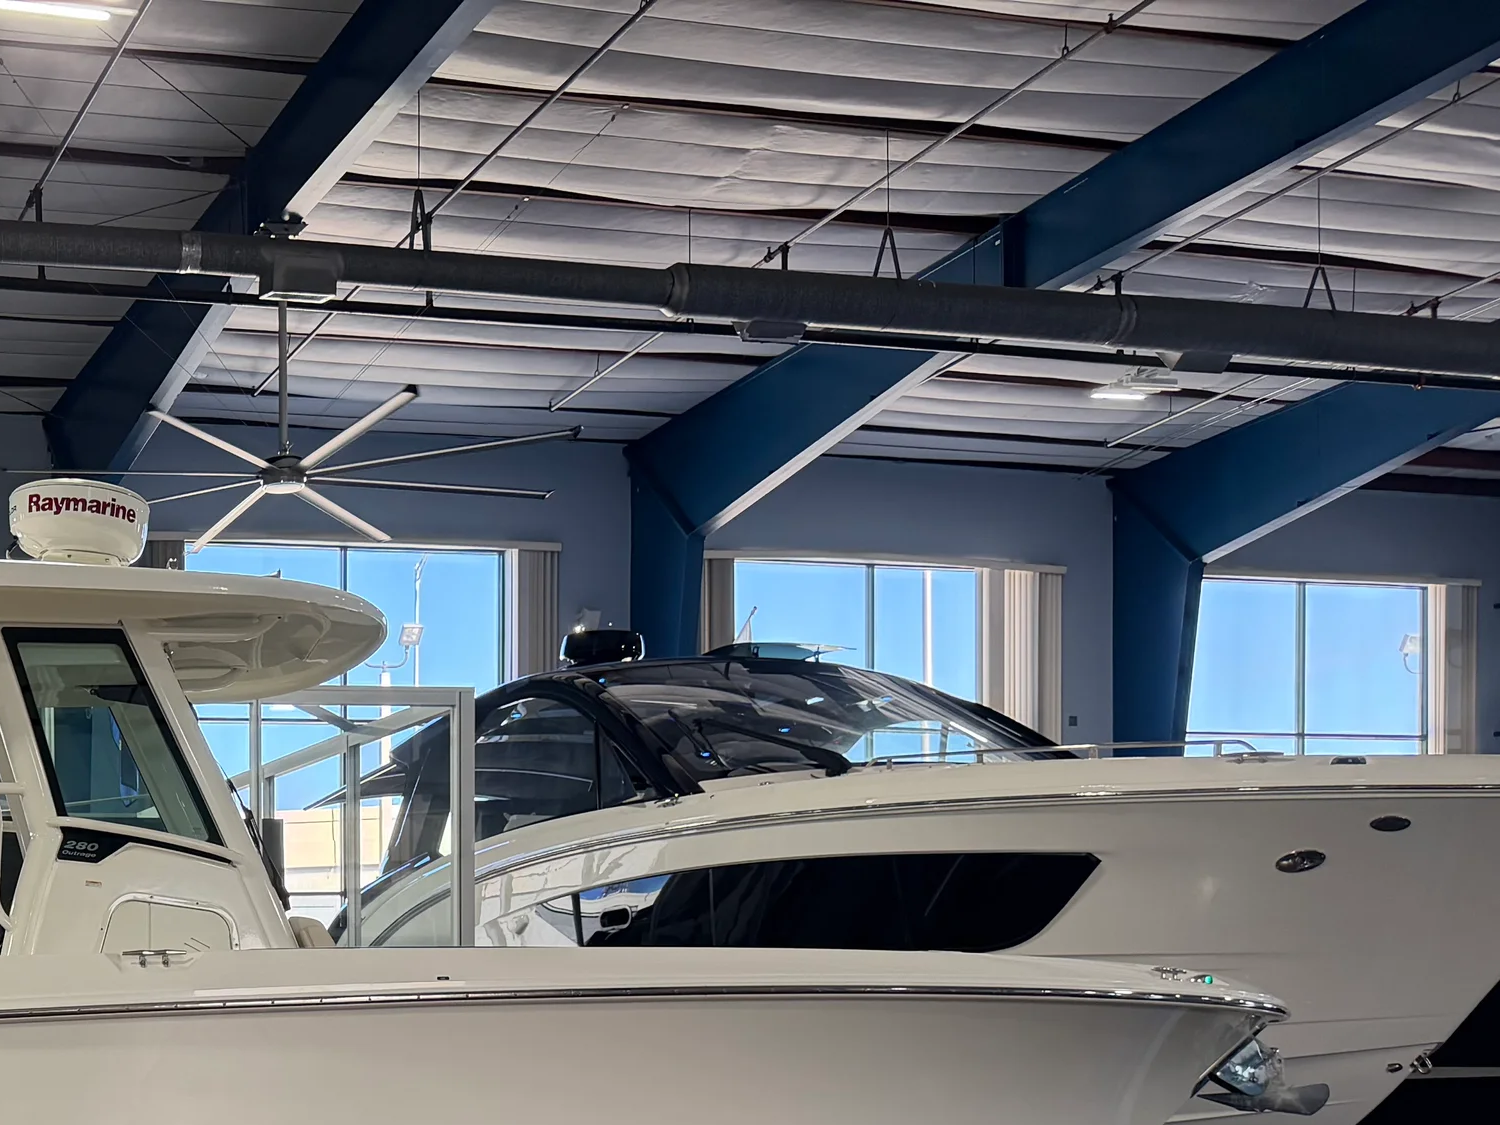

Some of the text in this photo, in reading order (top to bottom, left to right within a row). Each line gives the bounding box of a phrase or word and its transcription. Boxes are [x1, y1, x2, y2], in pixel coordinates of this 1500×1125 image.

[28, 493, 137, 523] Raymarine
[63, 840, 99, 852] 280
[61, 849, 97, 858] Outrage
